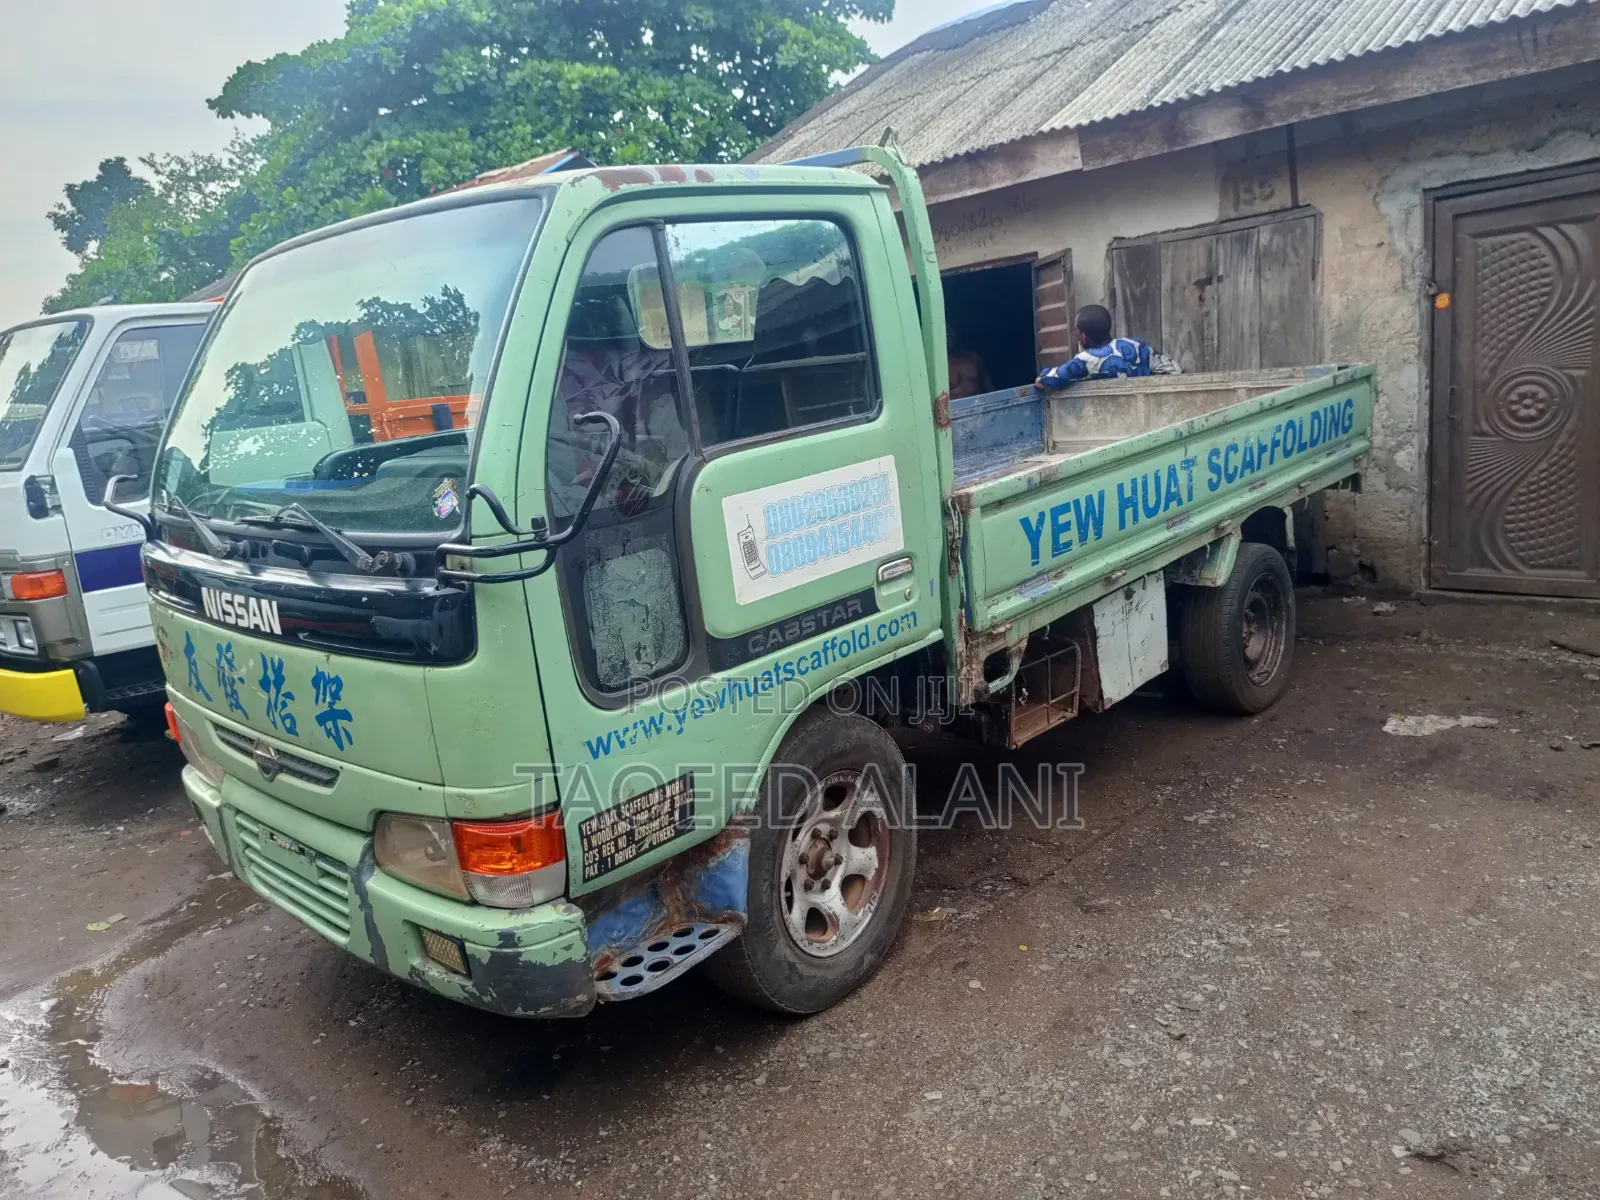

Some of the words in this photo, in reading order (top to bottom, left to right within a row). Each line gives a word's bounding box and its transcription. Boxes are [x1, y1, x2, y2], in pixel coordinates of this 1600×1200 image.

[1018, 488, 1106, 567] YEW
[1116, 455, 1198, 531] HUAT
[1207, 398, 1354, 492] SCAFFOLDING
[201, 586, 283, 636] NISSAN
[747, 598, 864, 654] CABSTAR
[585, 610, 919, 761] www.yewhuatscaffold.com
[581, 818, 598, 837] YEW
[621, 789, 664, 817] SCAFFOLDING
[591, 819, 630, 847] WOODLANDS
[633, 812, 649, 829] LOOP
[584, 846, 599, 866] CO'S
[602, 841, 615, 859] REG
[585, 864, 599, 879] PAX
[615, 844, 637, 866] DRIVER
[652, 825, 675, 846] OTHERS
